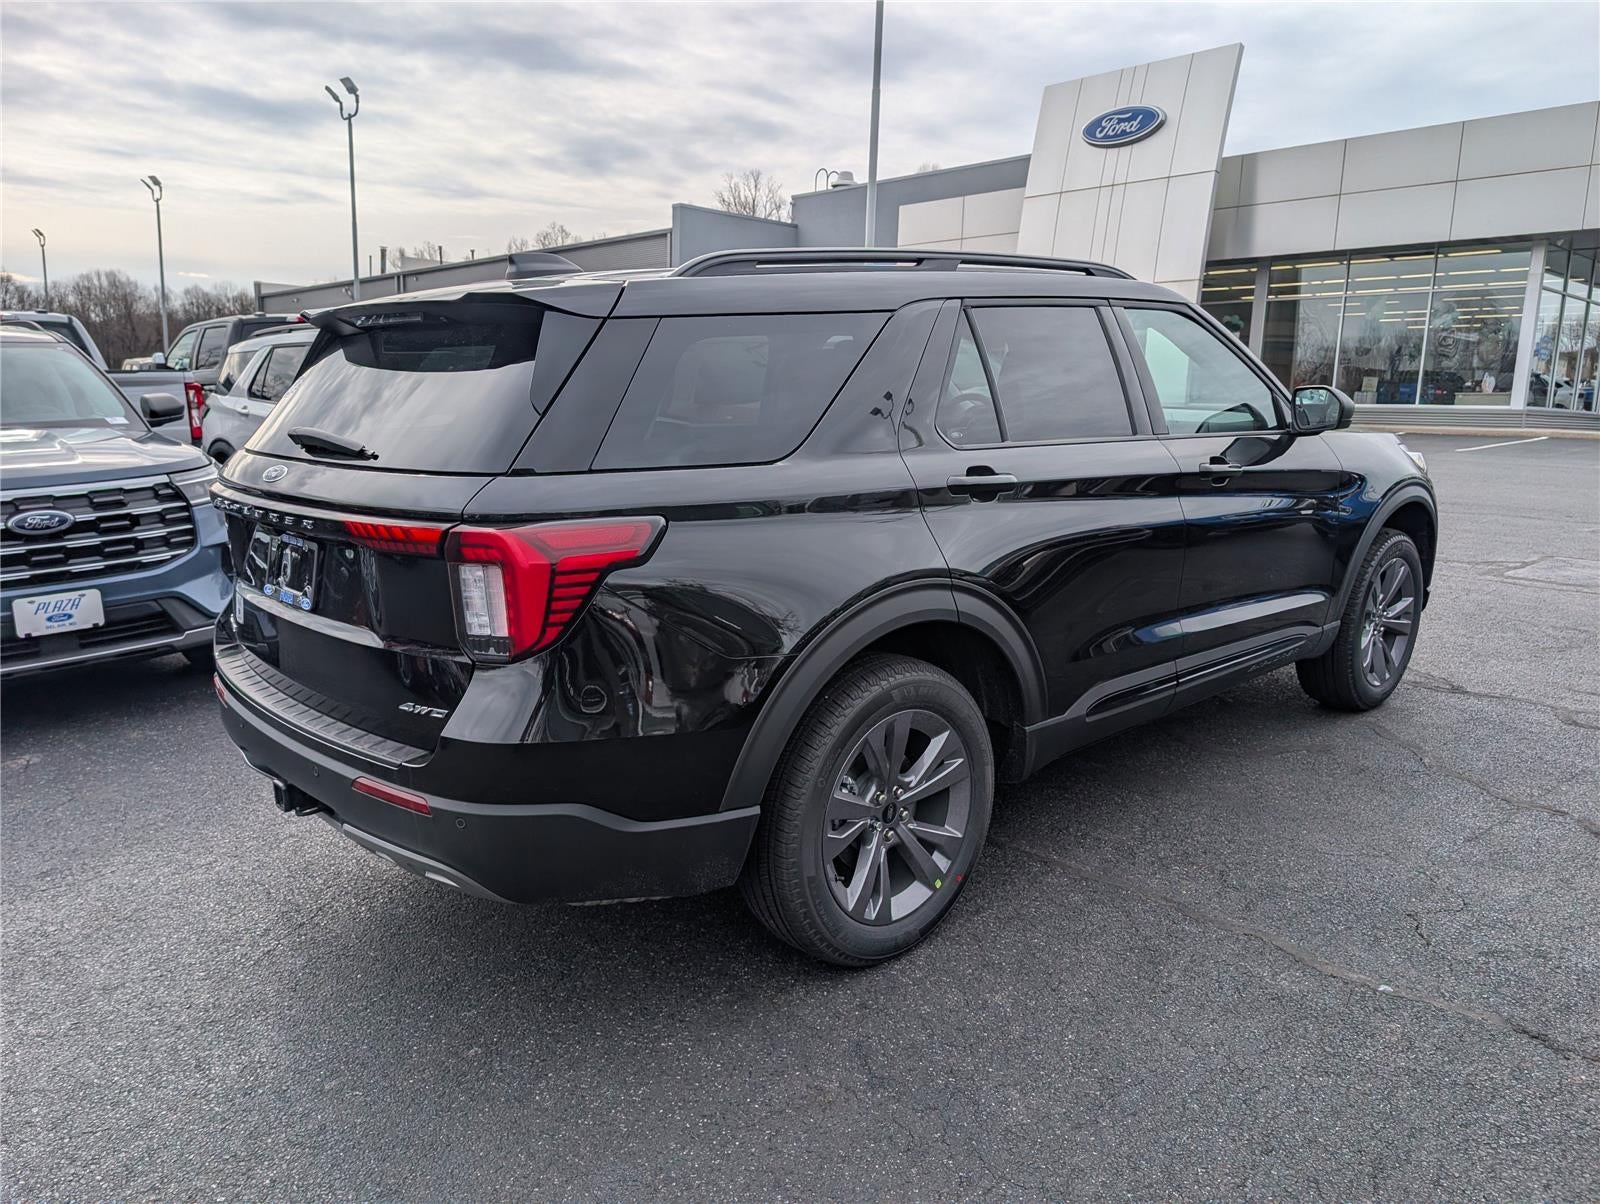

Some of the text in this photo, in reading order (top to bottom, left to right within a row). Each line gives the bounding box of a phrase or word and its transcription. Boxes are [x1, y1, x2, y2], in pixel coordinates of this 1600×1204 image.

[1096, 112, 1143, 138] Ford
[24, 515, 60, 529] Ford
[34, 597, 82, 615] PLAZA
